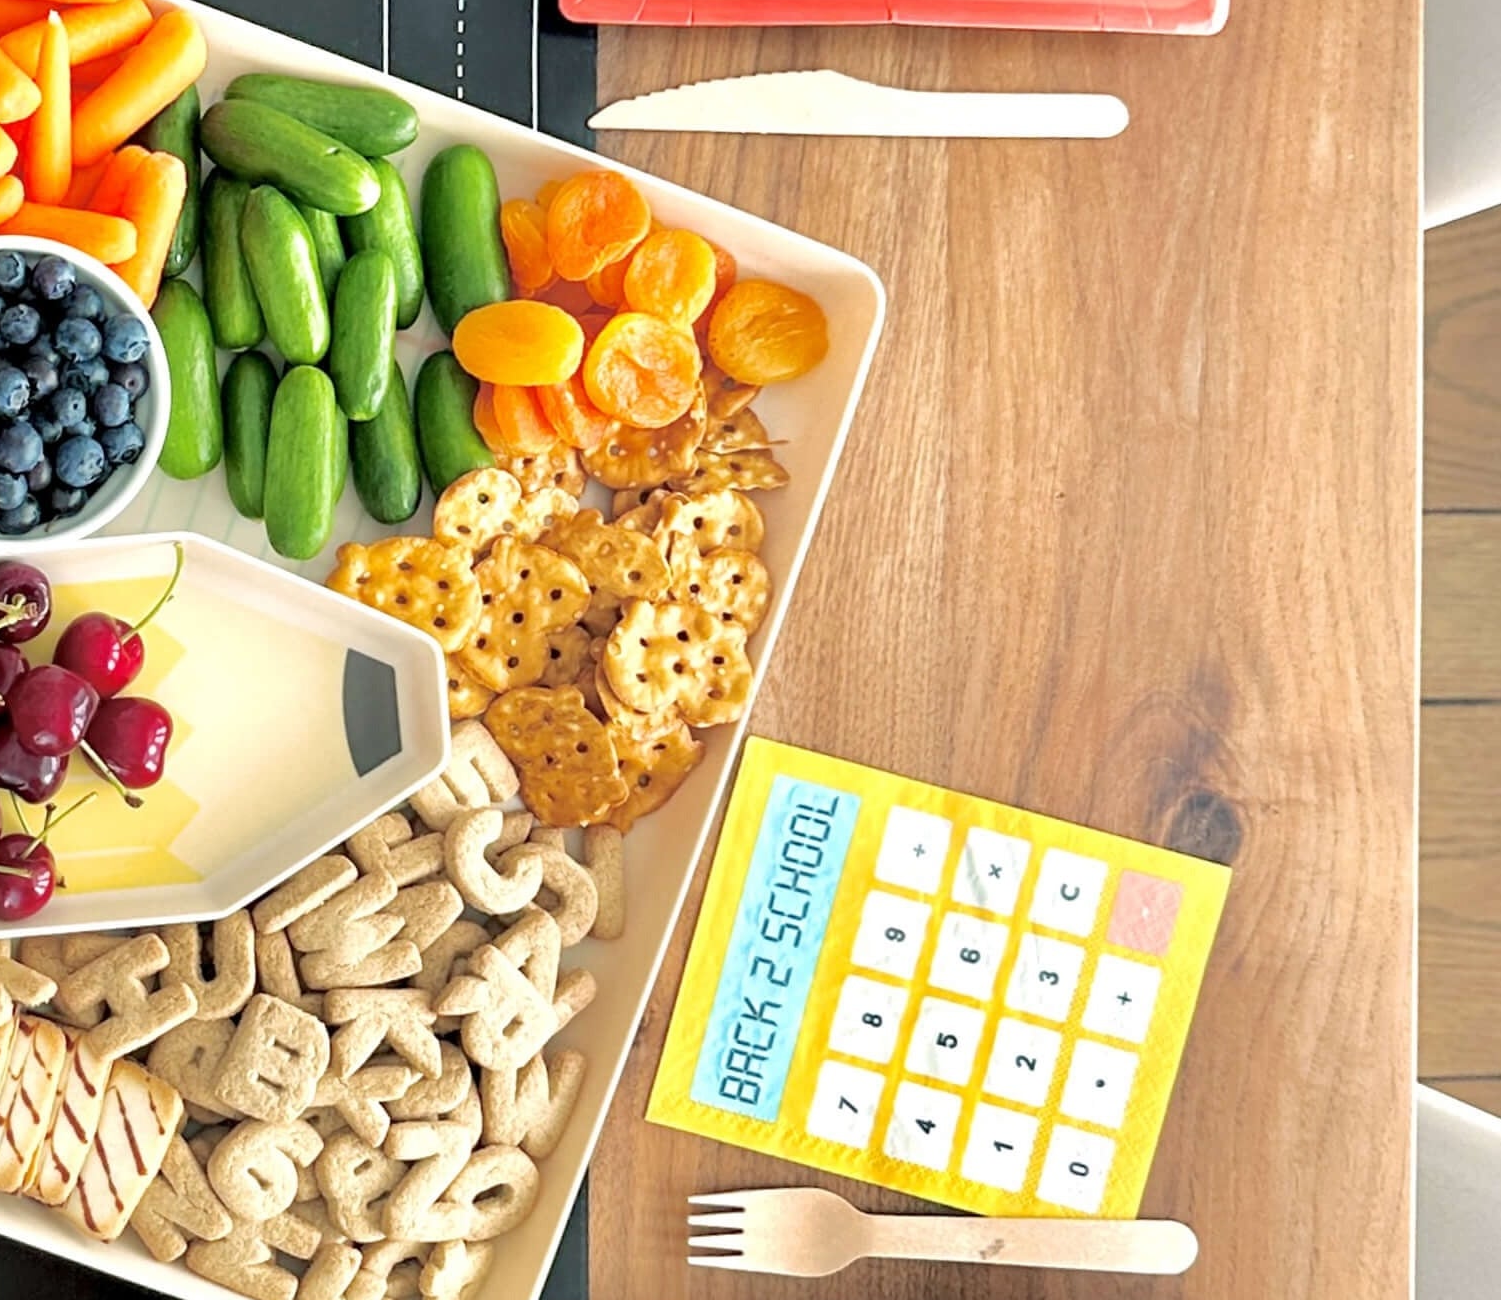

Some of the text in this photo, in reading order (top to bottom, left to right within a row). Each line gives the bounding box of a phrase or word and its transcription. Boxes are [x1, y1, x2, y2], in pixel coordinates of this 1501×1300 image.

[1060, 883, 1080, 902] C
[884, 927, 906, 943] 9
[718, 795, 840, 1107] BACK 2 SCHOOL
[959, 947, 981, 964] 6
[1038, 970, 1059, 986] 3
[862, 1012, 883, 1028] 8
[936, 1032, 958, 1049] 5
[1015, 1055, 1037, 1071] 2
[838, 1096, 859, 1114] 7
[915, 1119, 936, 1135] 4
[993, 1141, 1014, 1152] 1
[1069, 1161, 1089, 1177] 0
